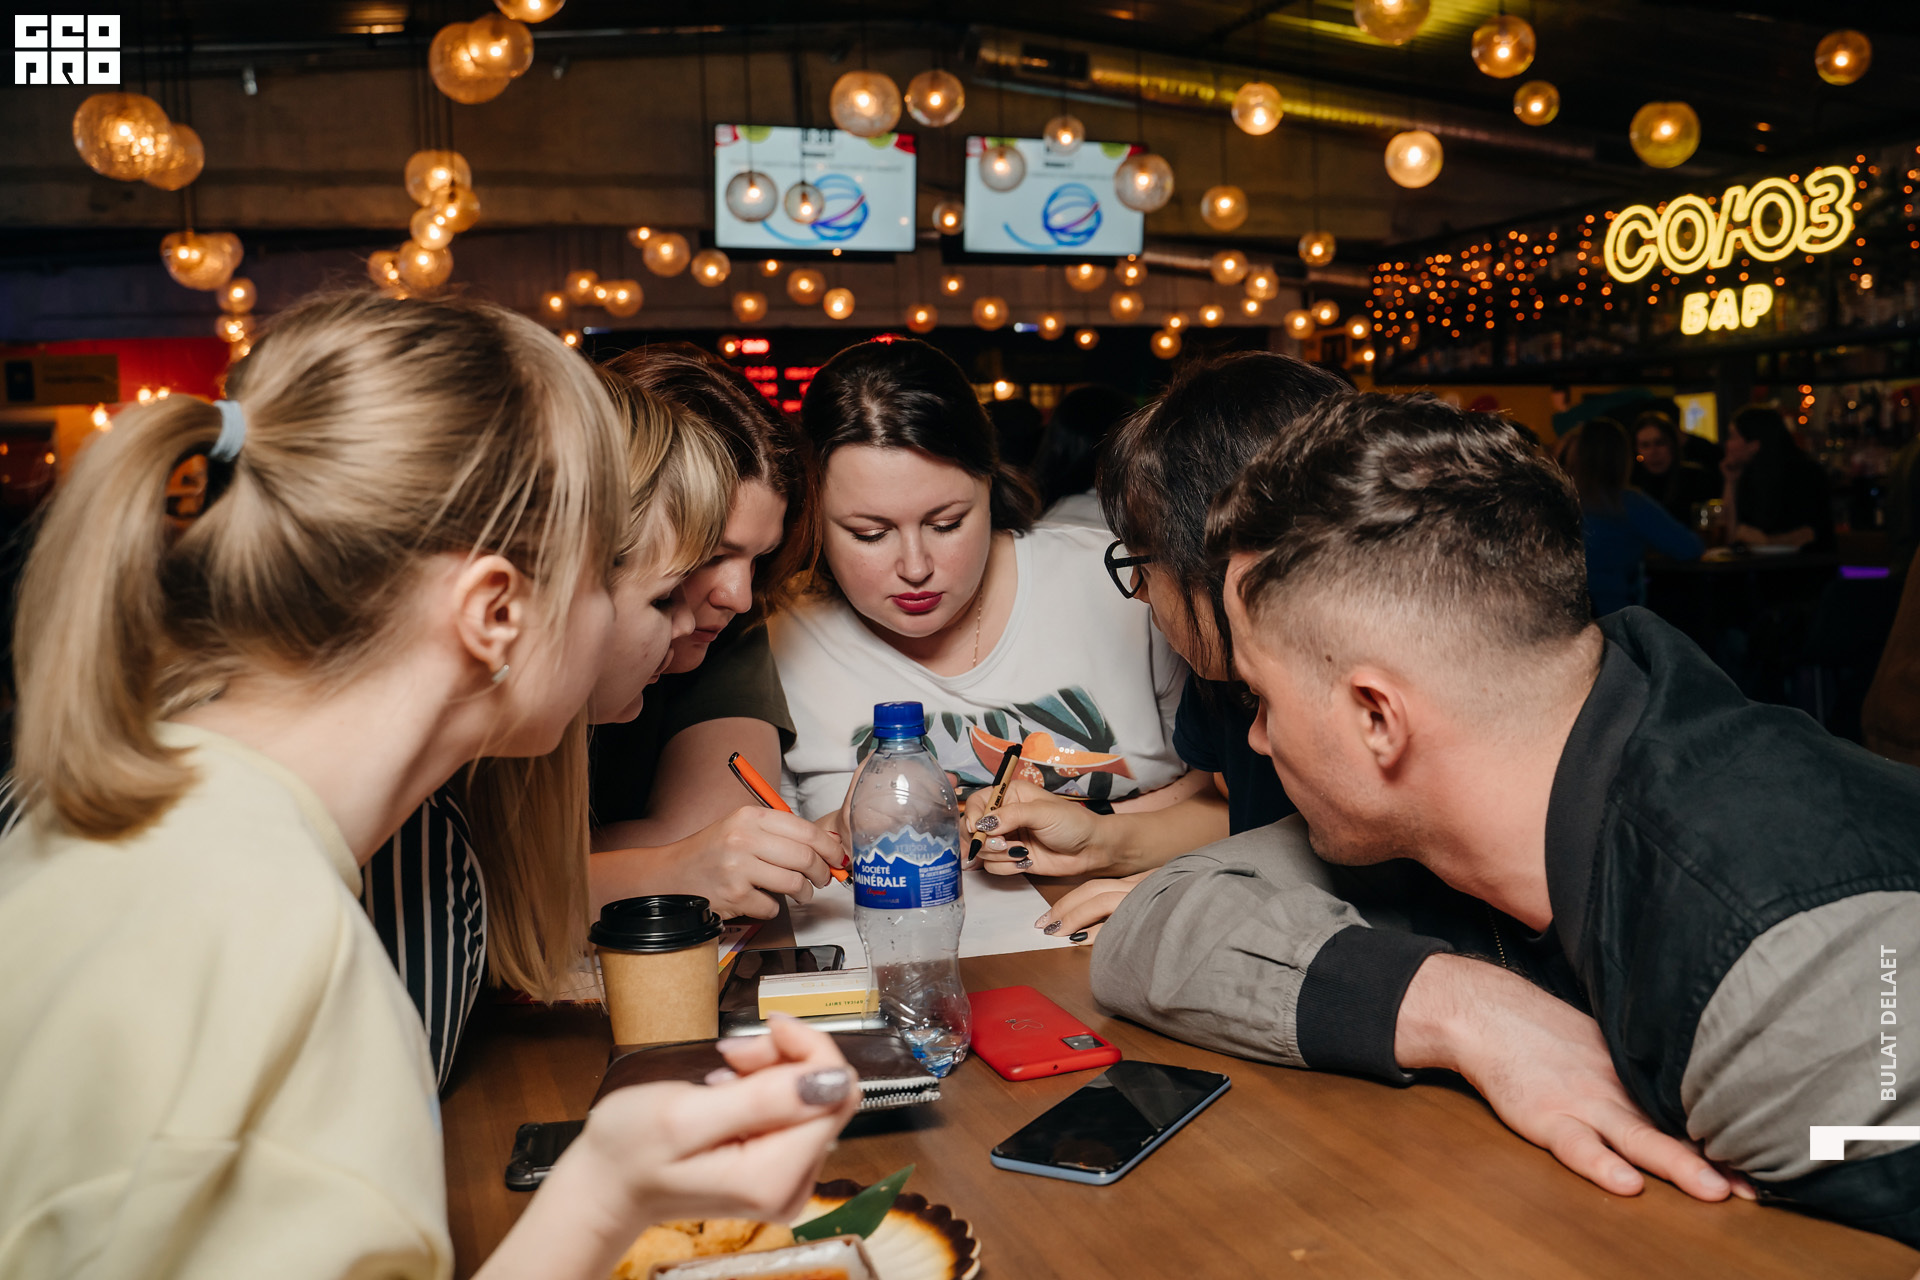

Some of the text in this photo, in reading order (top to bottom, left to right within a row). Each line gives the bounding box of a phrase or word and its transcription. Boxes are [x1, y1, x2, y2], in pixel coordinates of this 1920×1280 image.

[1604, 165, 1855, 283] СОЮЗ
[1681, 283, 1773, 335] БАР
[855, 872, 907, 888] MINÉRALE
[862, 865, 890, 875] SOCIÉTÉ
